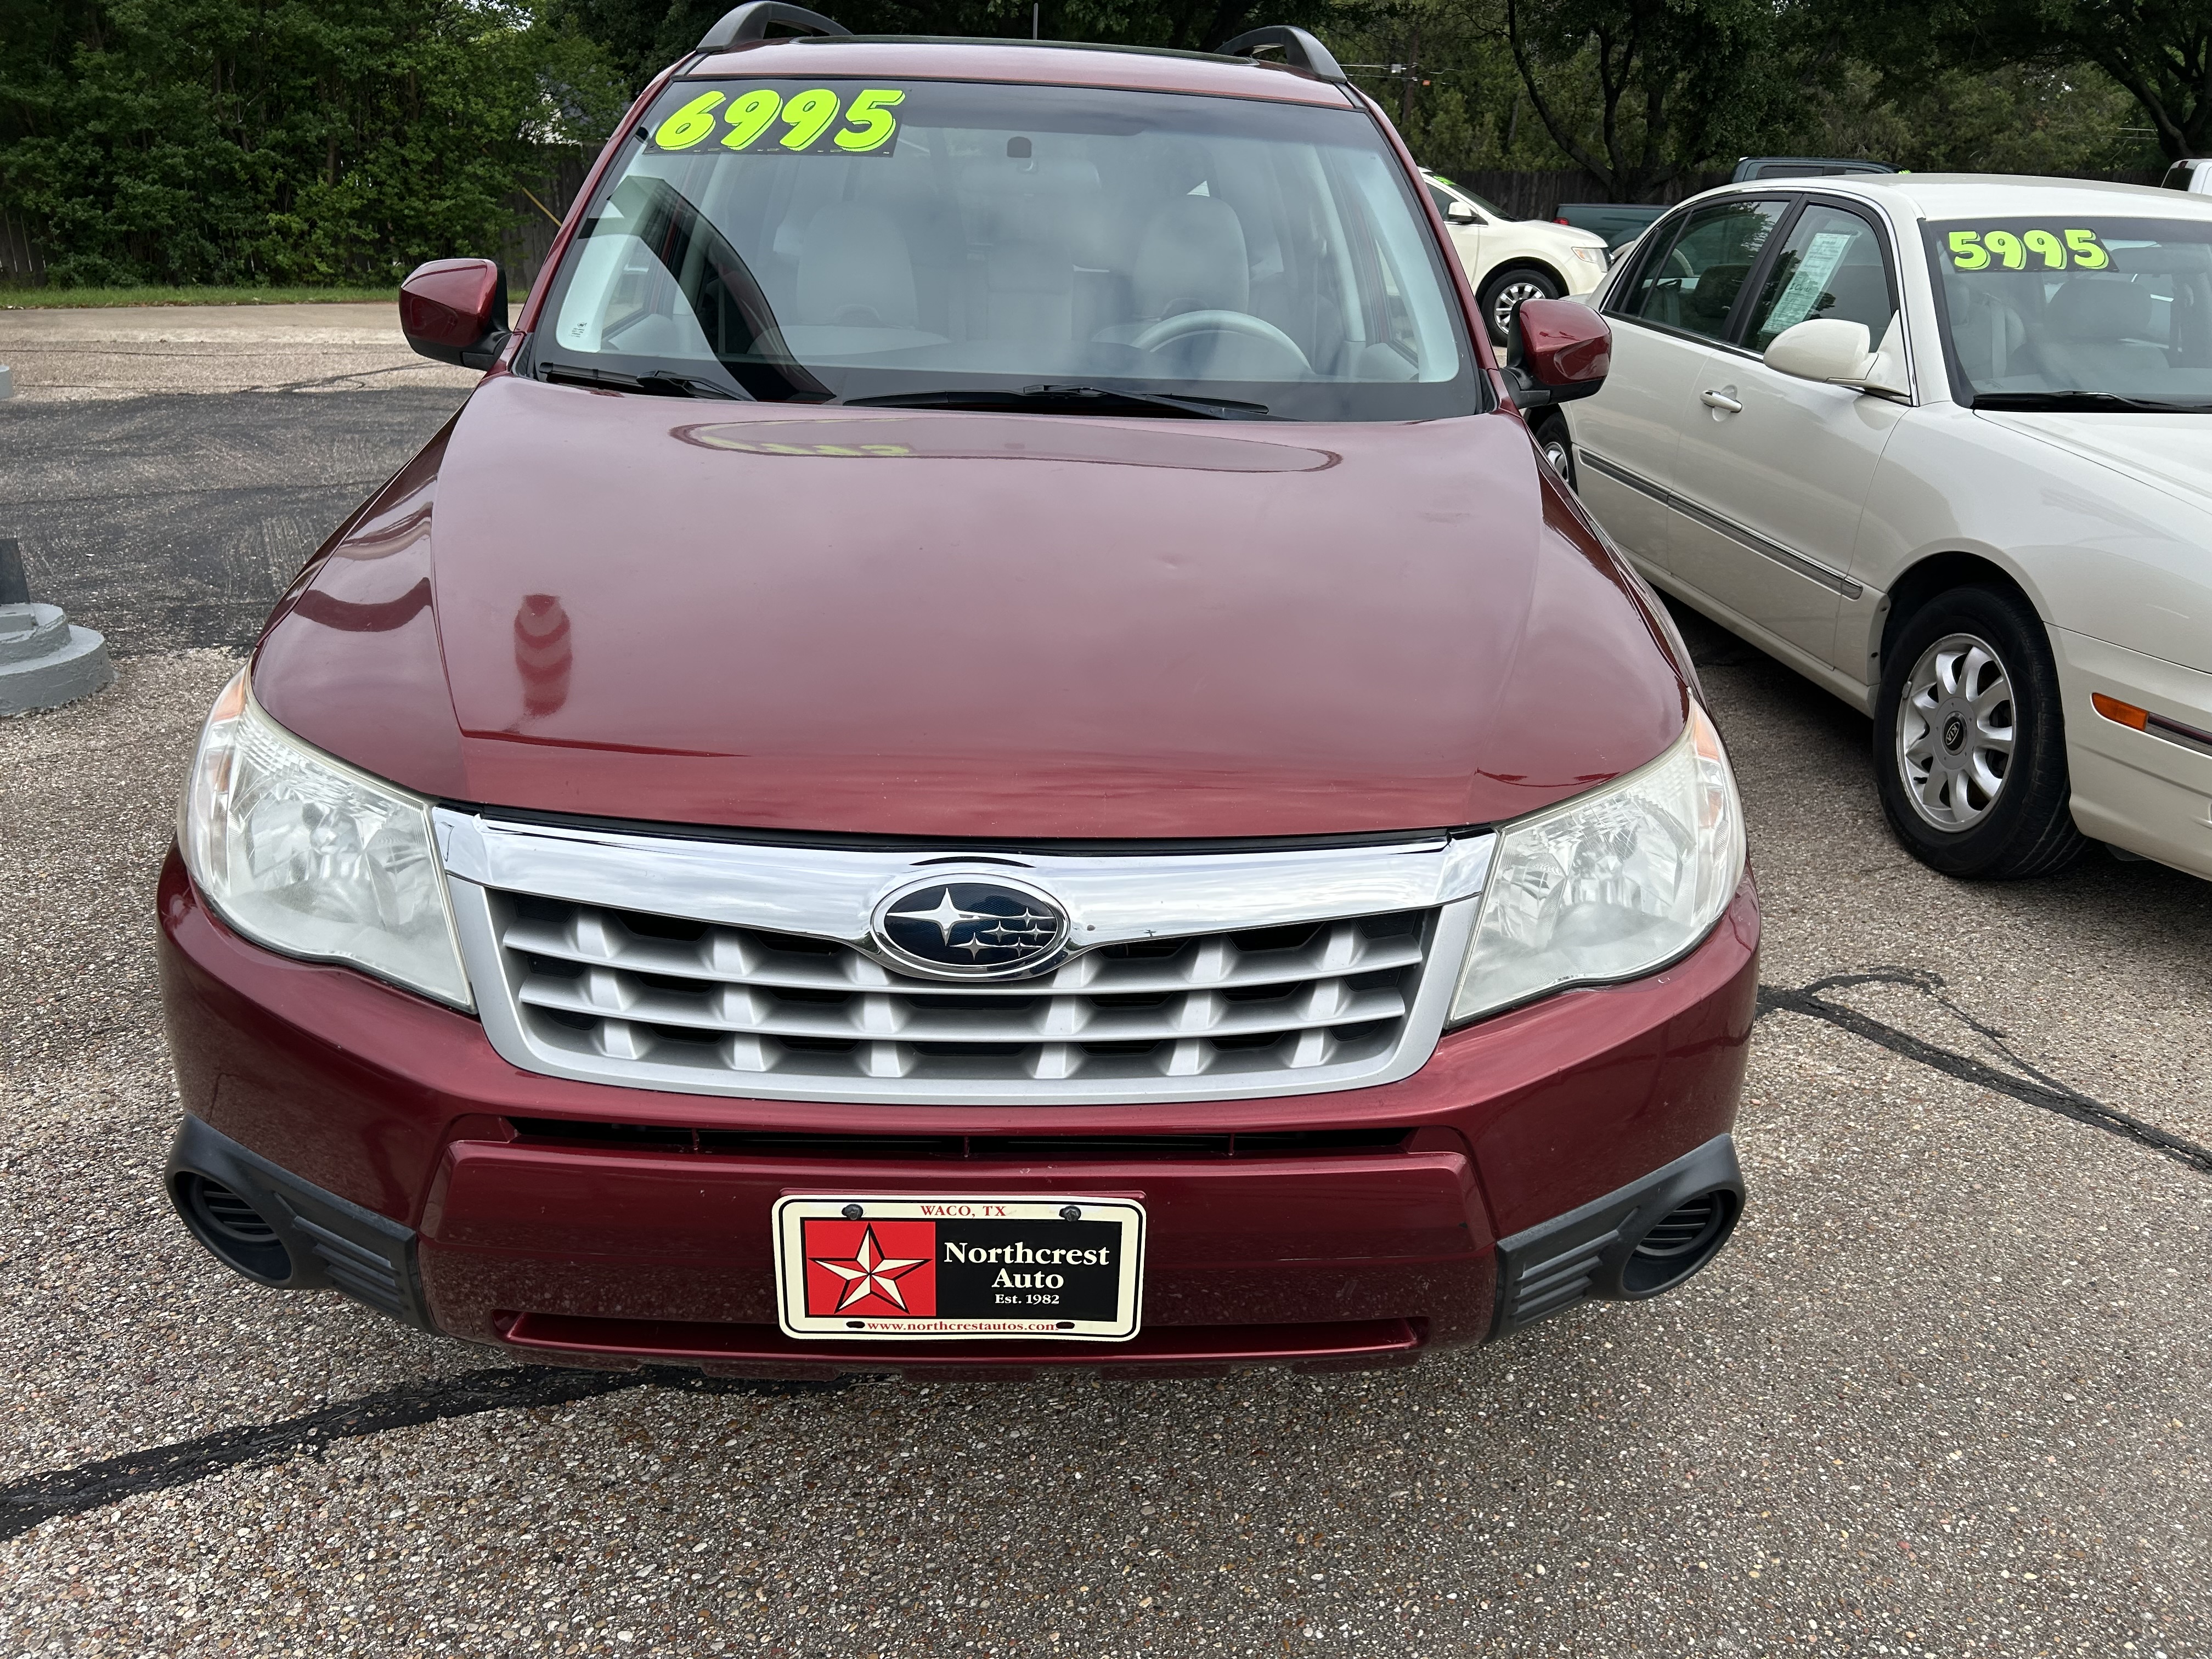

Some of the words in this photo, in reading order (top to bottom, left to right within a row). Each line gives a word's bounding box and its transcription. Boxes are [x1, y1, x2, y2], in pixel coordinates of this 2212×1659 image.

[655, 89, 906, 151] 6995
[1949, 229, 2109, 270] 5995
[1946, 725, 1958, 741] KIA
[920, 1205, 975, 1218] WACO,
[983, 1205, 1007, 1216] TX
[944, 1242, 1110, 1265] Northcrest
[991, 1268, 1064, 1289] Auto
[995, 1294, 1022, 1304] Est.
[1025, 1294, 1059, 1305] 1982
